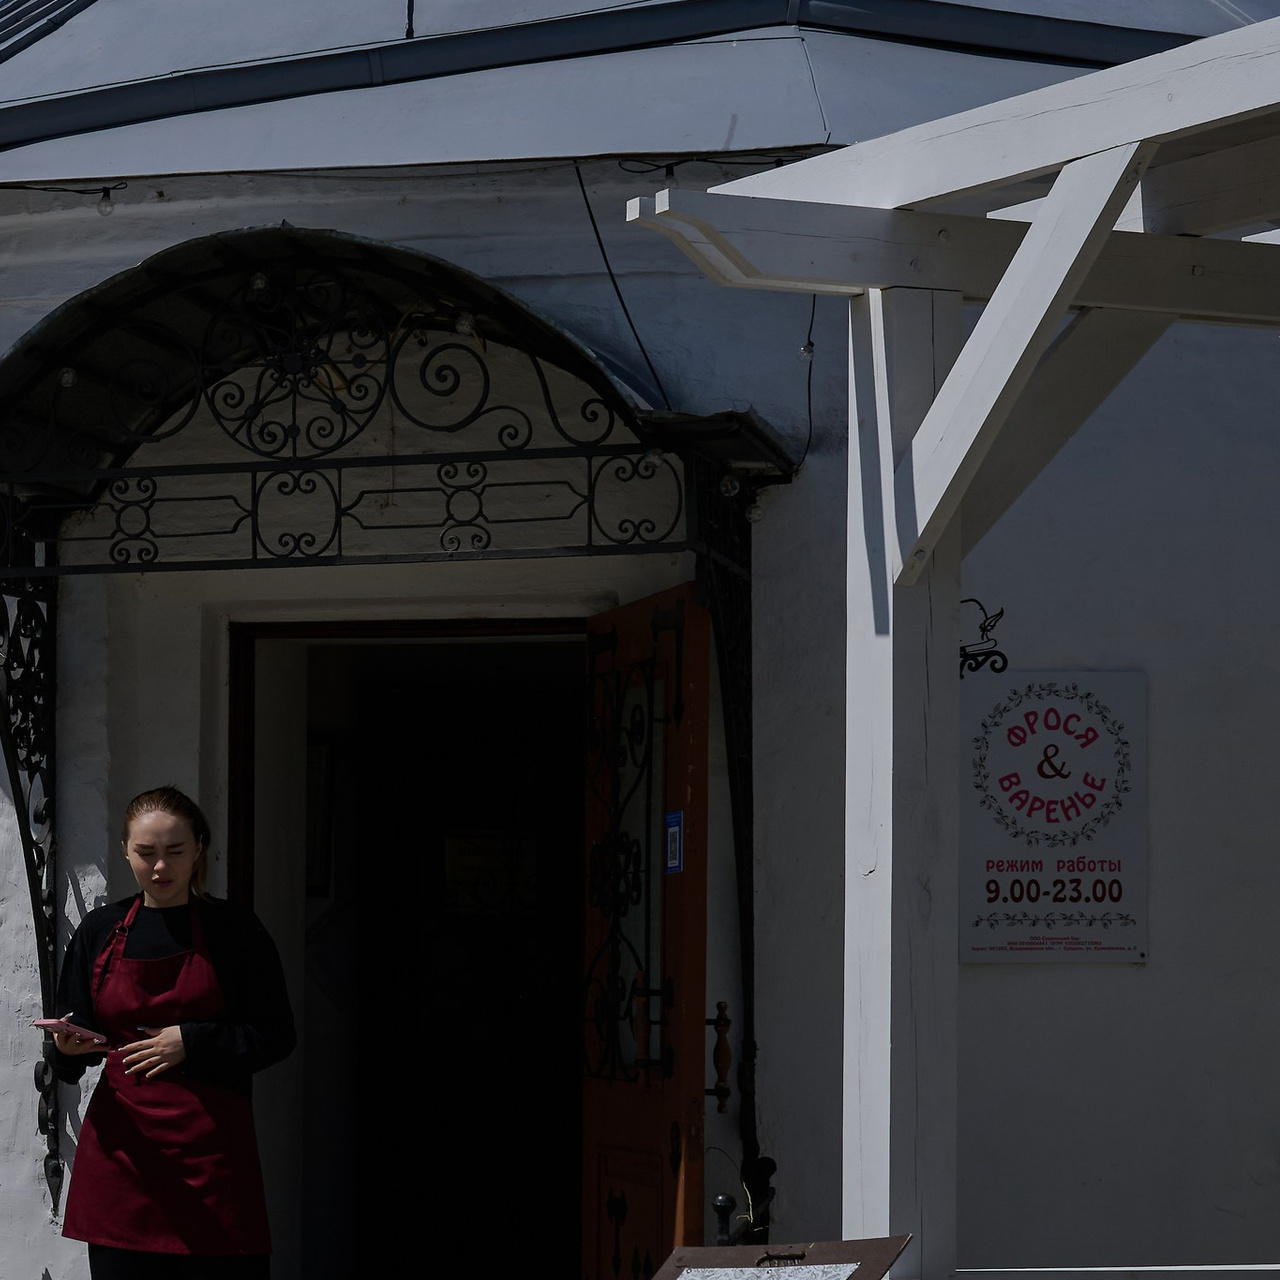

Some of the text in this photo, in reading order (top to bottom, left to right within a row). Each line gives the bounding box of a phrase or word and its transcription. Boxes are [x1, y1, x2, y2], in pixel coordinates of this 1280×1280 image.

[1006, 707, 1099, 749] ФРОСЯ
[1036, 743, 1072, 780] &
[998, 772, 1107, 824] ВАРЕНЬЕ
[986, 855, 1122, 873] режим работы
[985, 878, 1123, 904] 9.00-23.00
